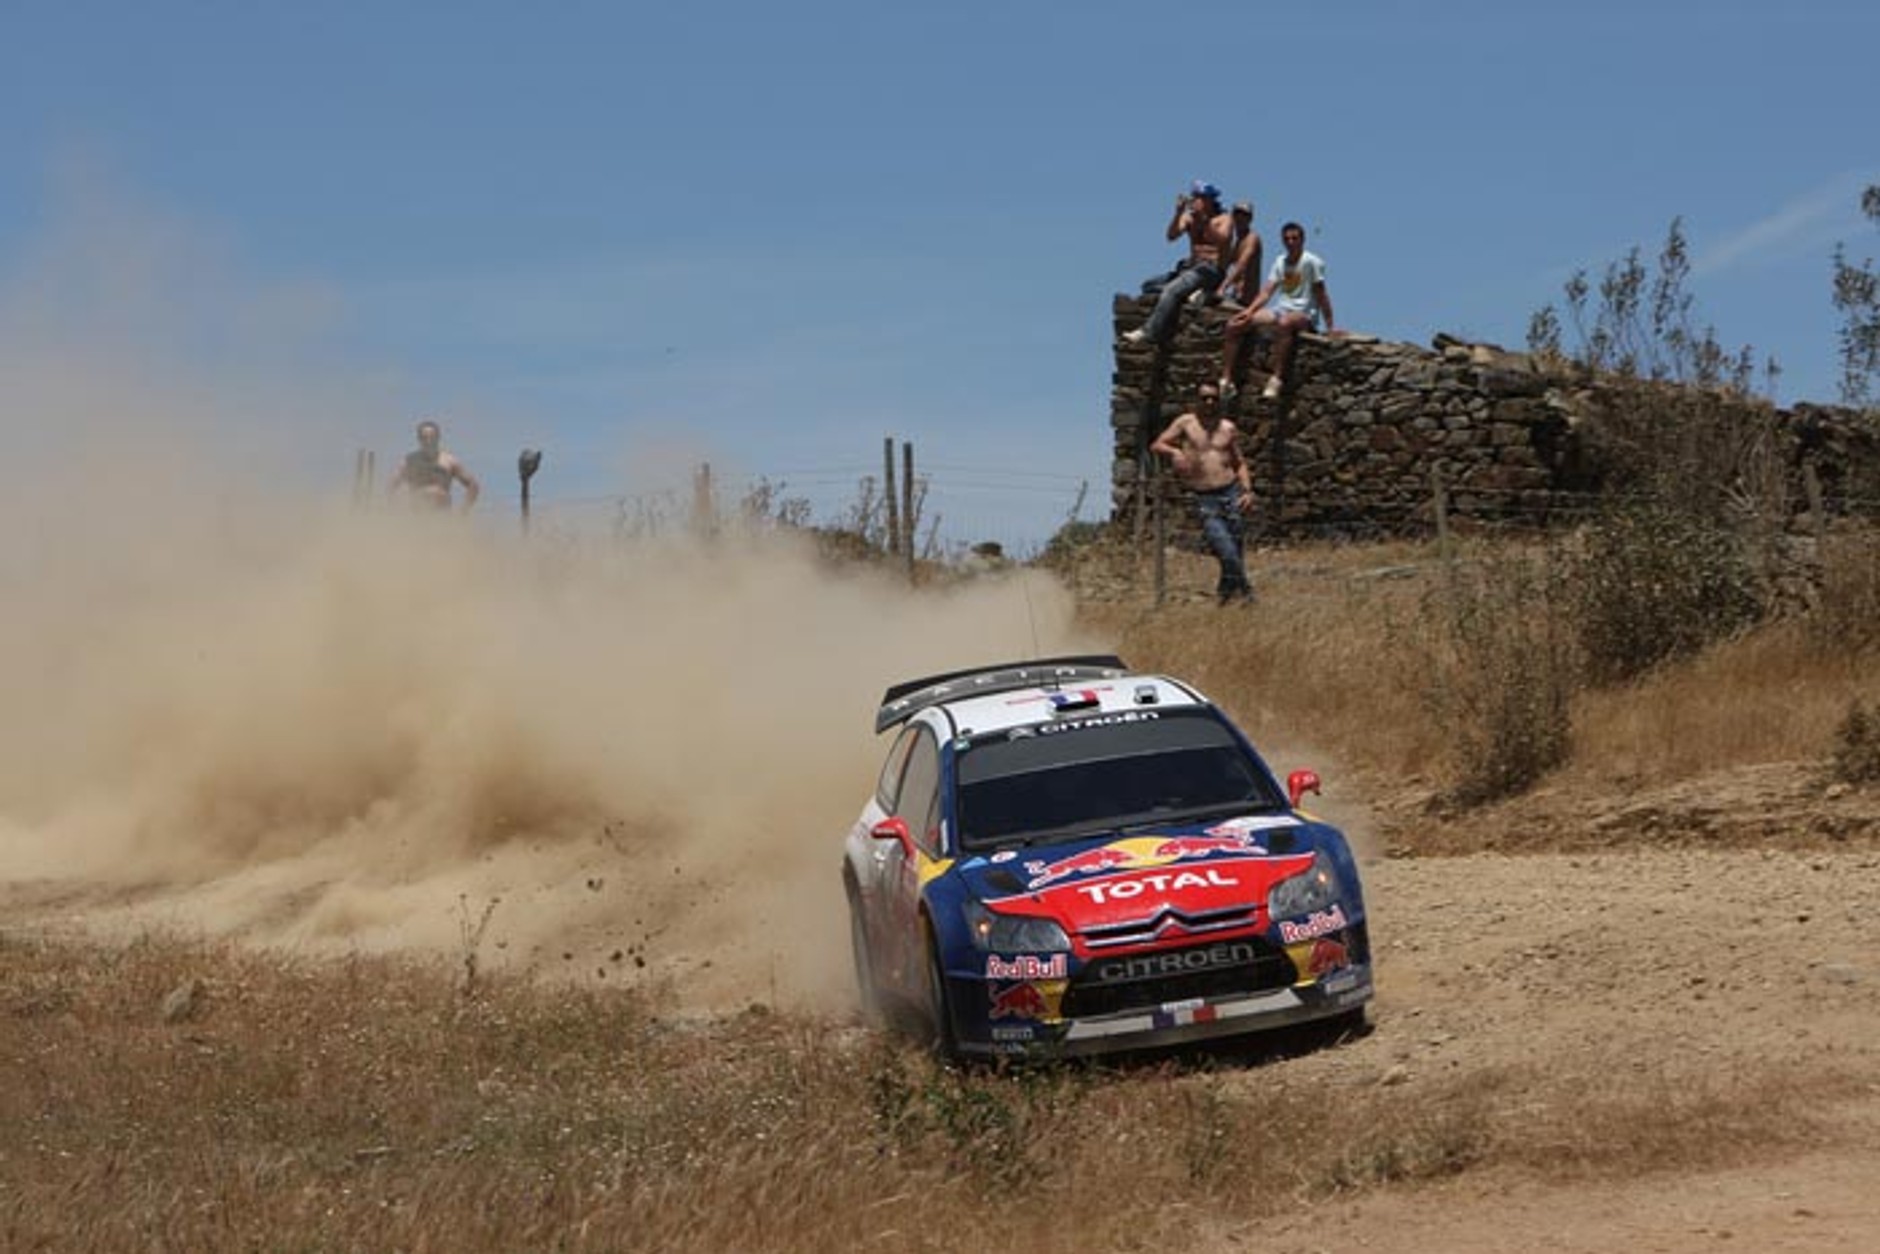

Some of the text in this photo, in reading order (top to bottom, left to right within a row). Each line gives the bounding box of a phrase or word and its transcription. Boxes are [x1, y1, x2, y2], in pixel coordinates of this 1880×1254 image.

[1078, 869, 1240, 904] TOTAL
[987, 953, 1067, 978] Red Bull
